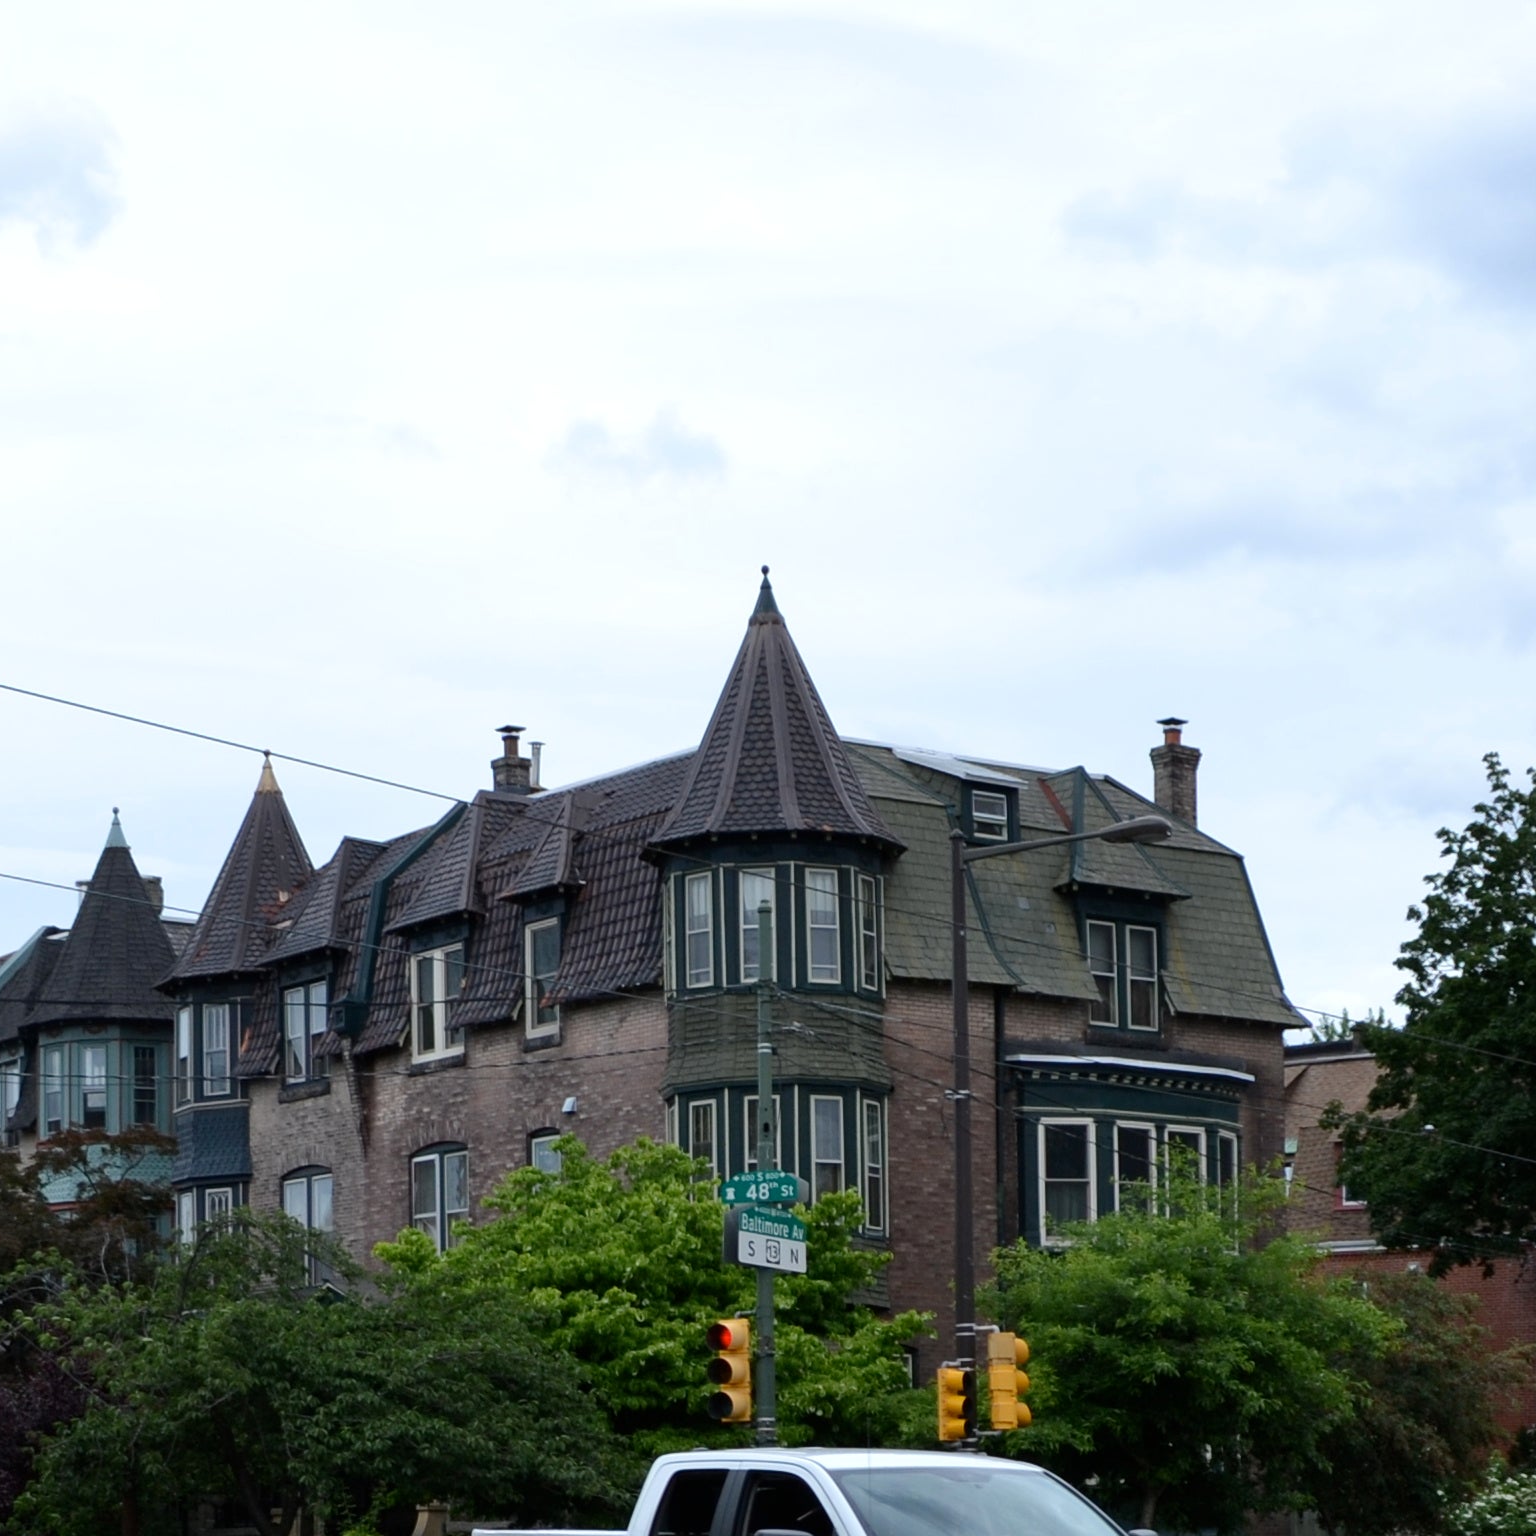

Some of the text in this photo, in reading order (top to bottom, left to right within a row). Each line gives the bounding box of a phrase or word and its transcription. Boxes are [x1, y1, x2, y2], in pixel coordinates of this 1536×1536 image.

[757, 1172, 764, 1182] S
[746, 1181, 794, 1201] 48th St
[741, 1212, 790, 1238] Baltimore
[792, 1224, 805, 1240] Av
[747, 1240, 799, 1264] S 13 N
